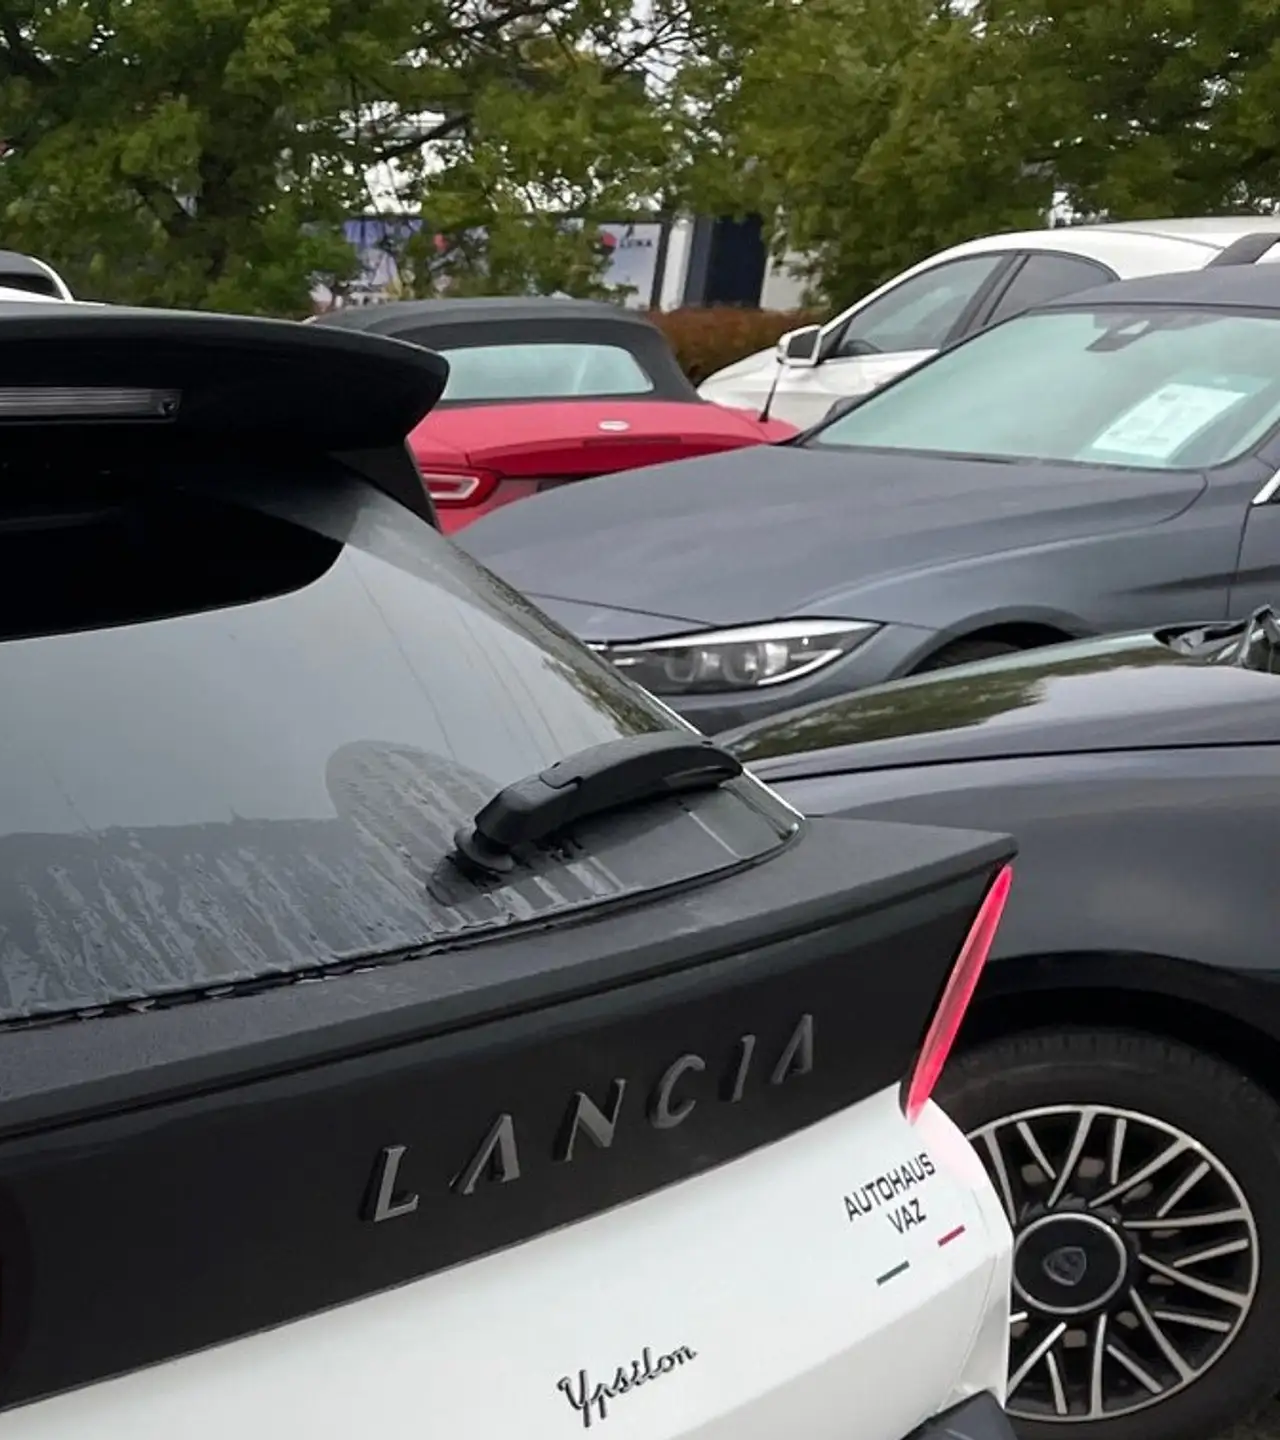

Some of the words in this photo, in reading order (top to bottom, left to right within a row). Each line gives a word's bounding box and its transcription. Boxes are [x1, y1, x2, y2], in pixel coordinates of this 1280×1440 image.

[368, 1012, 816, 1223] LANCIA
[843, 1152, 936, 1222] AUTOHAUS
[886, 1197, 927, 1234] VAZ
[556, 1345, 698, 1428] Ypsilon
